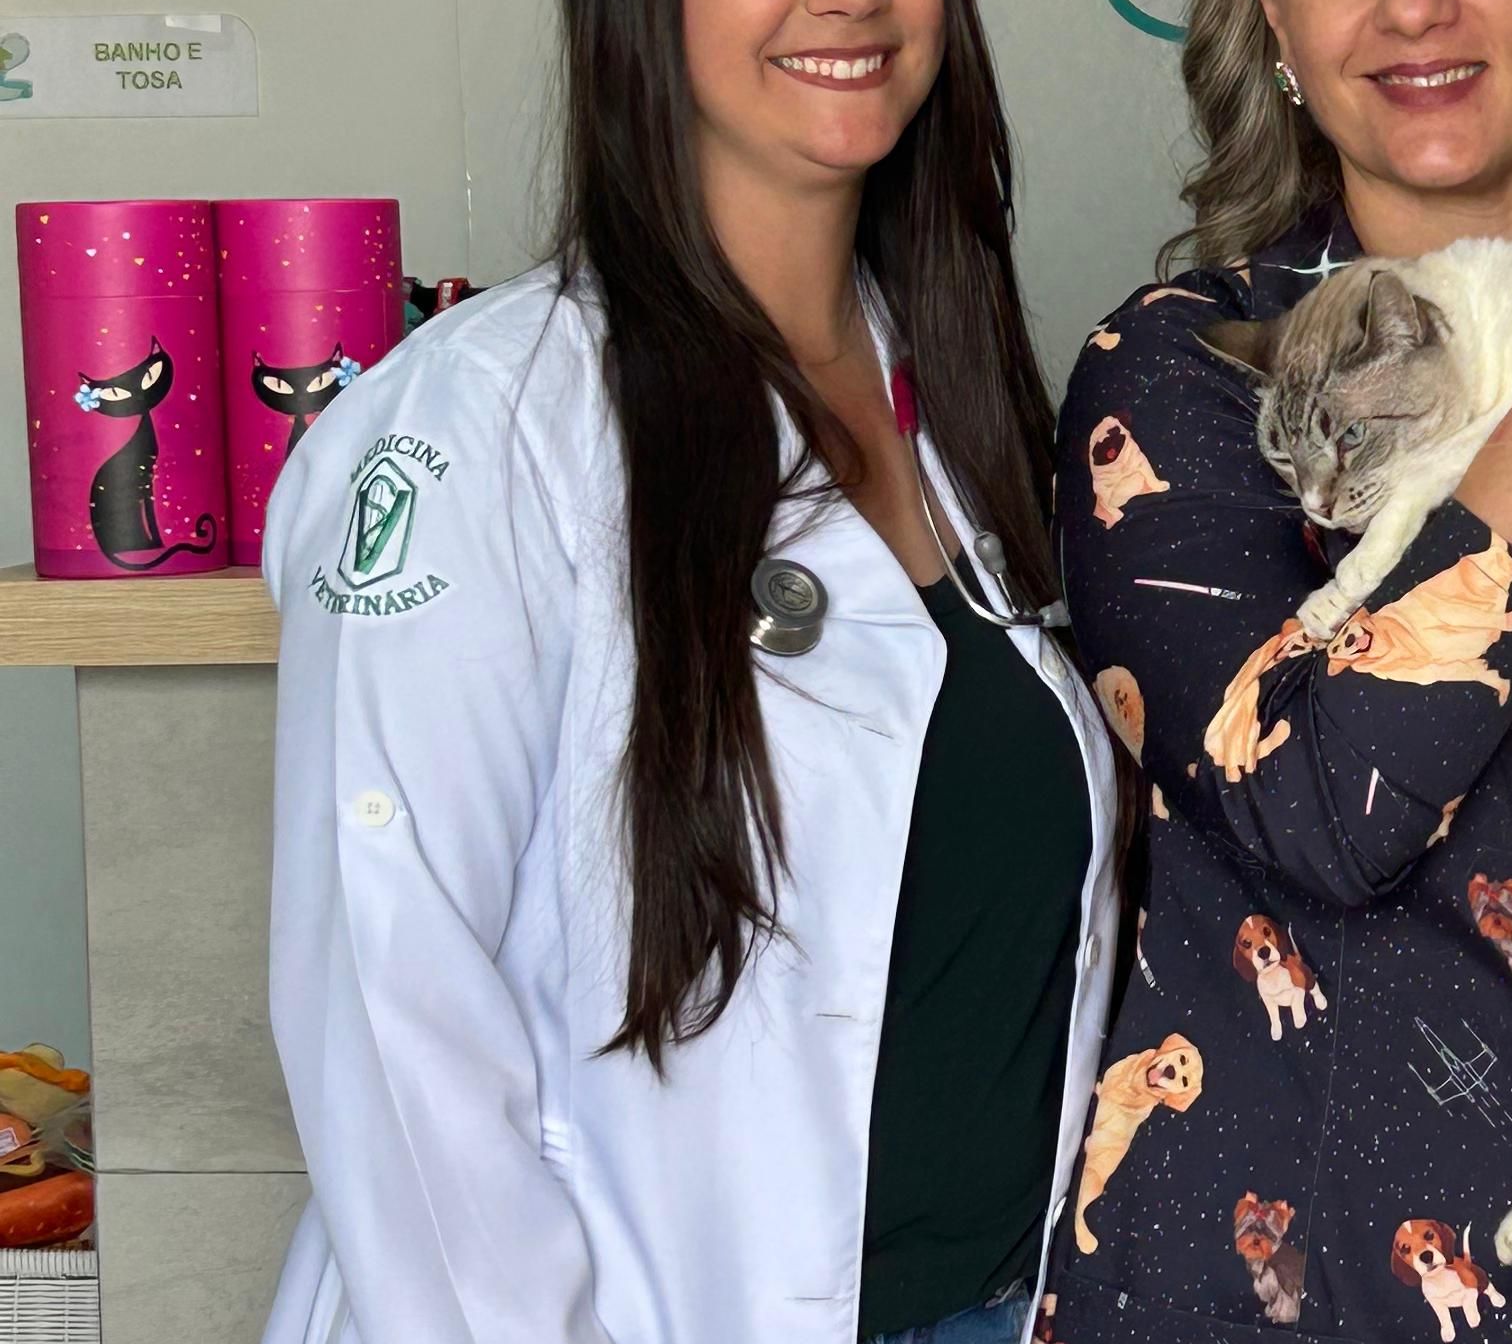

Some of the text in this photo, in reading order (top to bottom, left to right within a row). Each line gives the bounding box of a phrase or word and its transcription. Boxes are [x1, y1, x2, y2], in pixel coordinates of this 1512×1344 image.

[93, 42, 203, 62] BANHO E
[116, 70, 183, 90] TOSA
